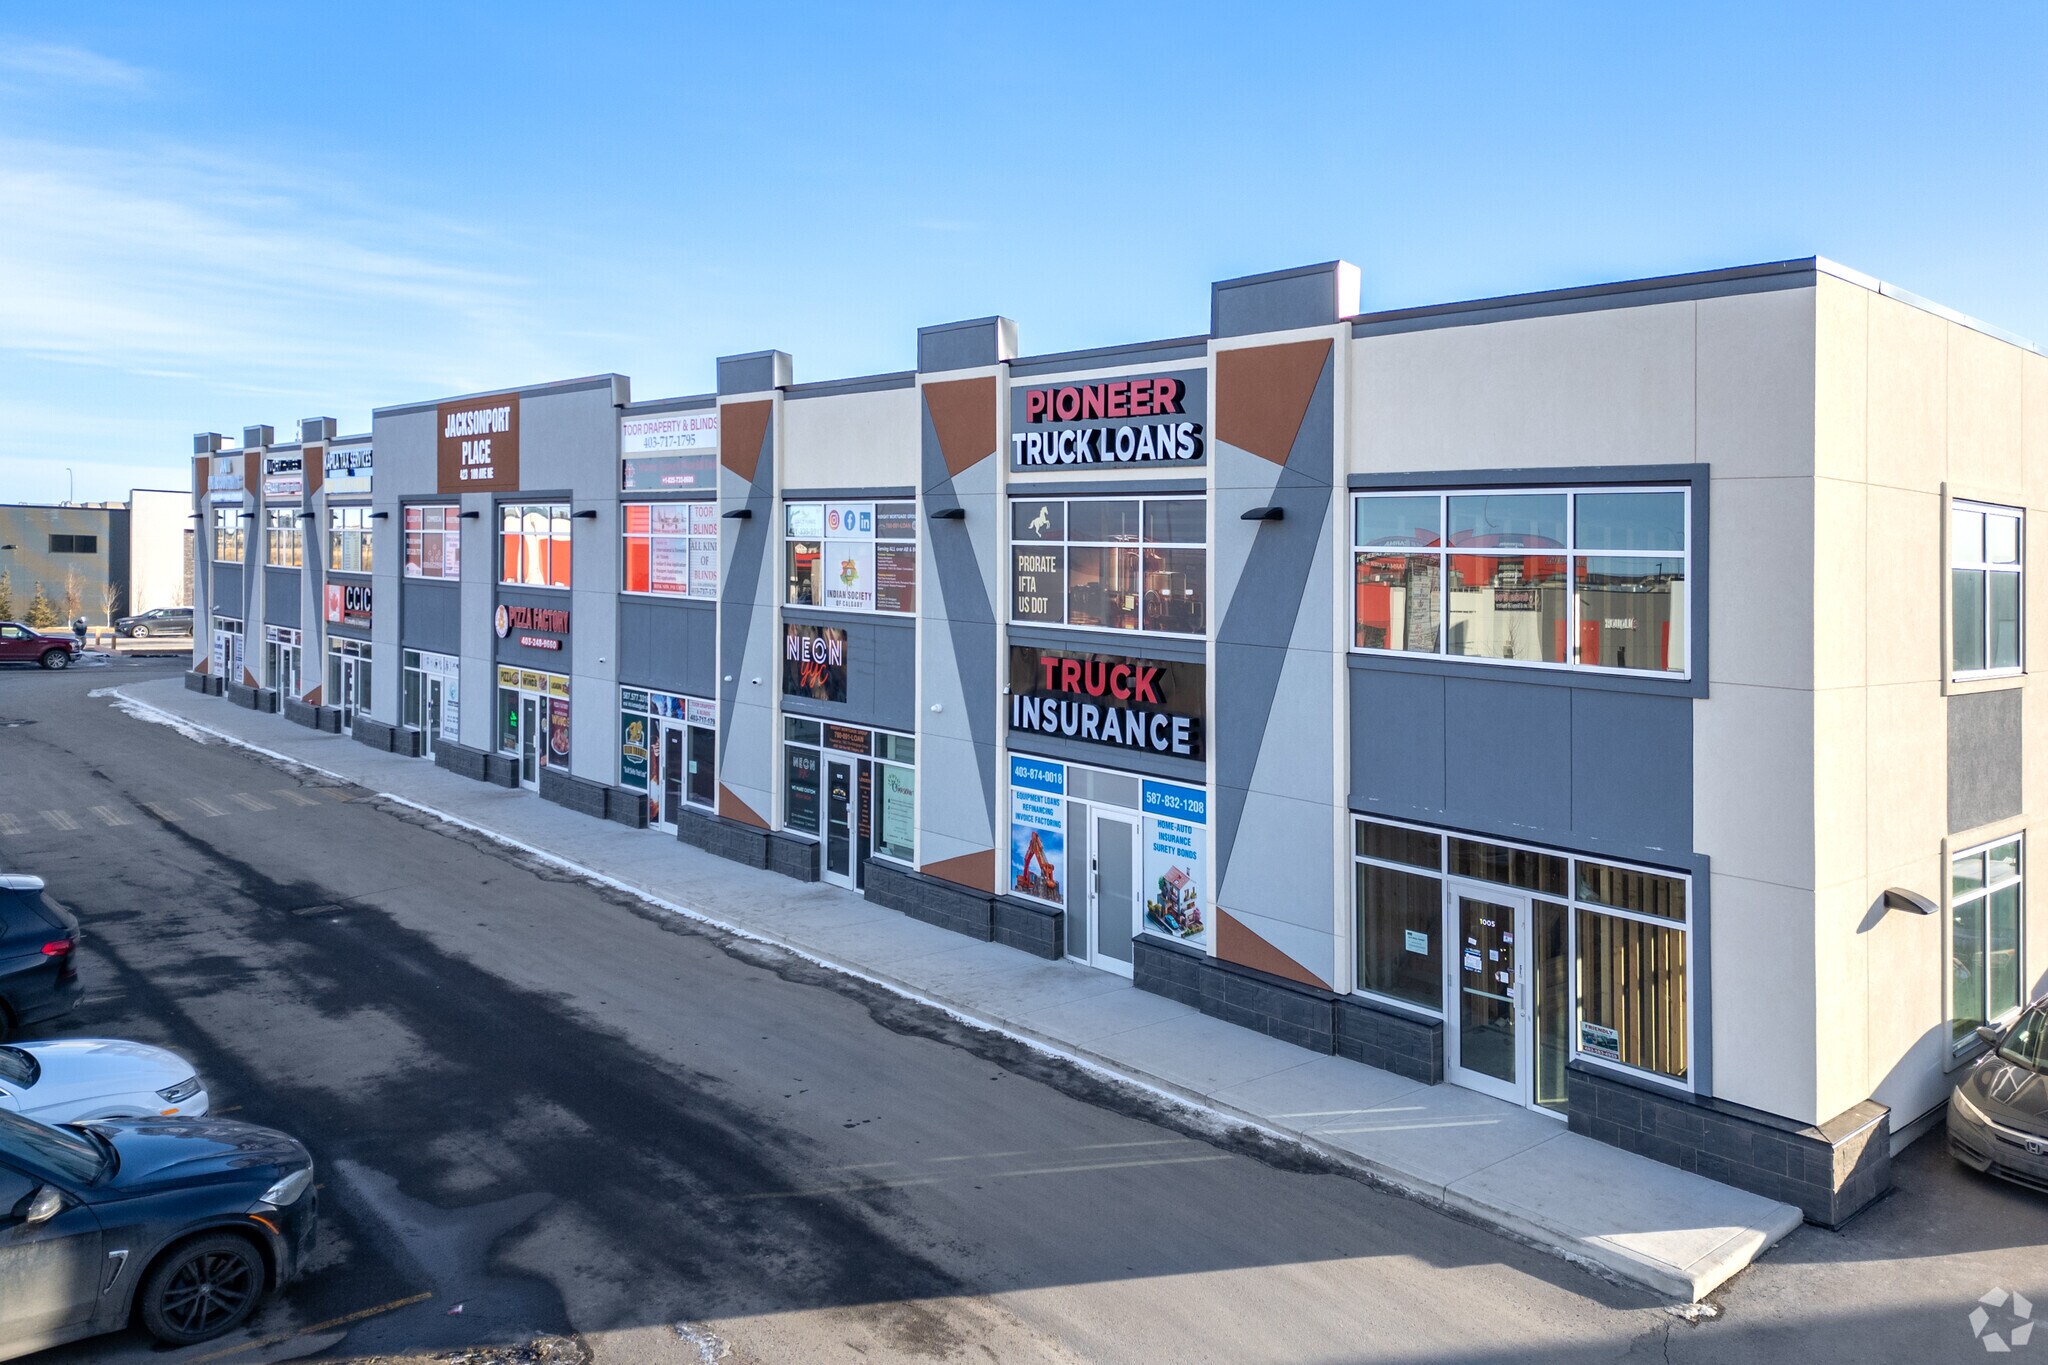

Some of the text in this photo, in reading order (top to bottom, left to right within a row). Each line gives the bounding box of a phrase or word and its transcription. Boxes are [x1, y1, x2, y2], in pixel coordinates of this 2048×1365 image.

[1026, 378, 1180, 422] PIONEER
[445, 406, 510, 438] JACKSONPORT
[624, 417, 717, 436] TOOR DRAPERTY & BLINDS
[644, 434, 696, 448] 403-717-1795
[1012, 422, 1197, 464] TRUCK LOANS
[462, 440, 491, 465] PLACE
[694, 506, 713, 517] TOOR
[694, 524, 717, 535] BLINDS
[691, 542, 702, 551] ALL
[701, 556, 709, 566] OF
[1018, 556, 1056, 573] PRORATE
[694, 570, 717, 580] BLINDS
[1018, 576, 1036, 592] IFTA
[346, 586, 371, 612] CCIC
[827, 590, 872, 600] INDIAN SOCIETY
[1018, 597, 1048, 614] US DOT
[509, 606, 568, 634] PIZZA FACTORY
[787, 636, 842, 666] NEON
[1040, 656, 1158, 704] TRUCK
[1014, 694, 1190, 754] INSURANCE
[793, 756, 815, 771] NEON
[1015, 766, 1062, 784] 403-874-0018
[1016, 792, 1060, 807] EQUIPMENT LOANS
[1146, 792, 1204, 814] 587-832-1208
[1022, 803, 1054, 816] REFINANCING
[1016, 813, 1061, 828] INVOICE FACTORING
[1157, 820, 1192, 834] HOME-AUTO
[1158, 832, 1191, 846] INSURANCE
[1153, 843, 1197, 860] SURETY BONDS
[1480, 918, 1496, 928] 1005
[1584, 1024, 1614, 1036] FRIENDLY
